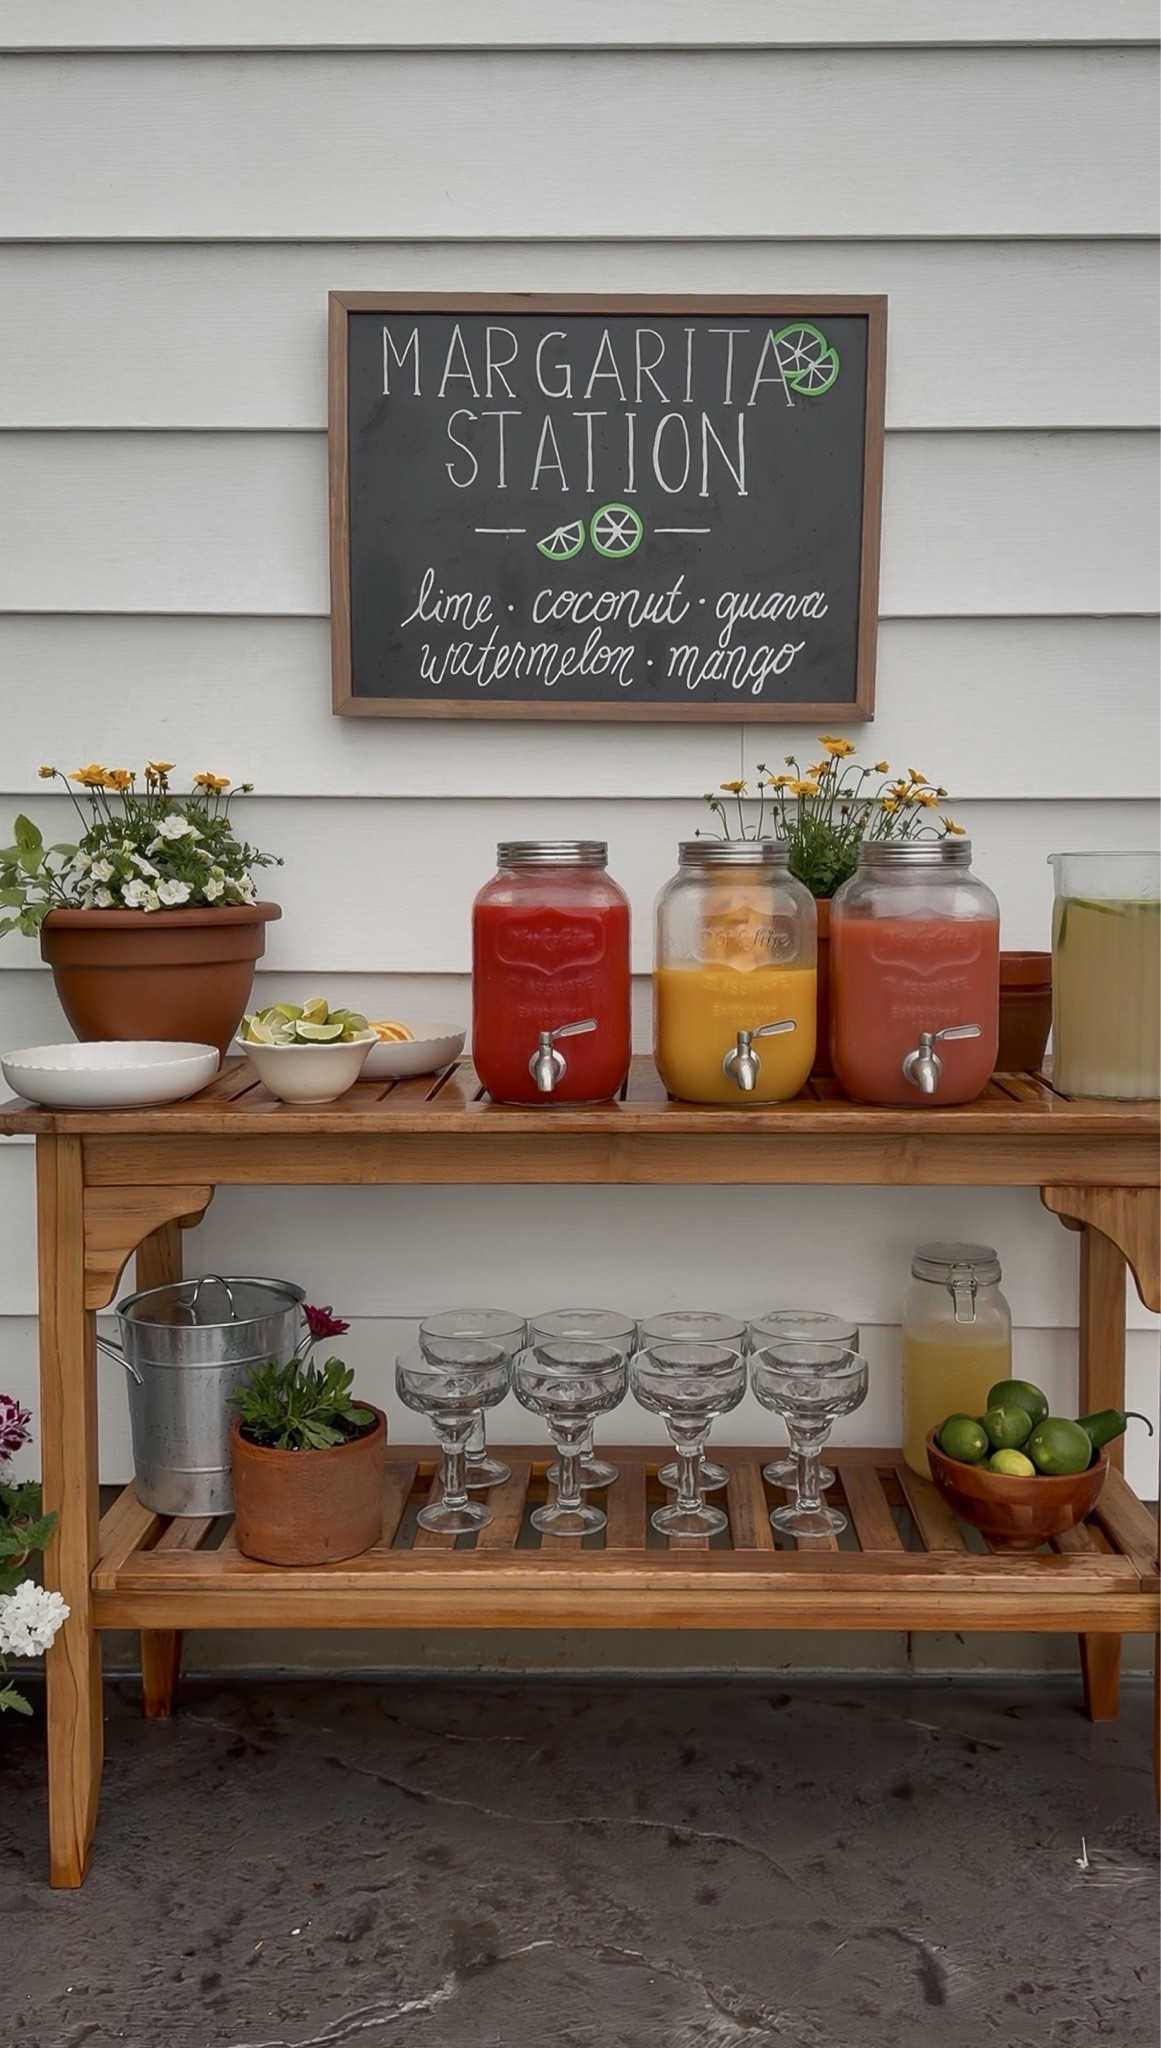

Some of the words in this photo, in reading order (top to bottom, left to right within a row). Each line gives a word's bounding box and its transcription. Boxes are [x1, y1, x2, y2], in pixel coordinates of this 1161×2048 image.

[383, 324, 796, 407] MARGARITA
[445, 409, 748, 496] STATION
[401, 567, 493, 630] lime
[532, 575, 690, 628] coconut
[715, 591, 829, 648] guava
[420, 625, 636, 687] watermelon
[667, 640, 806, 695] mango
